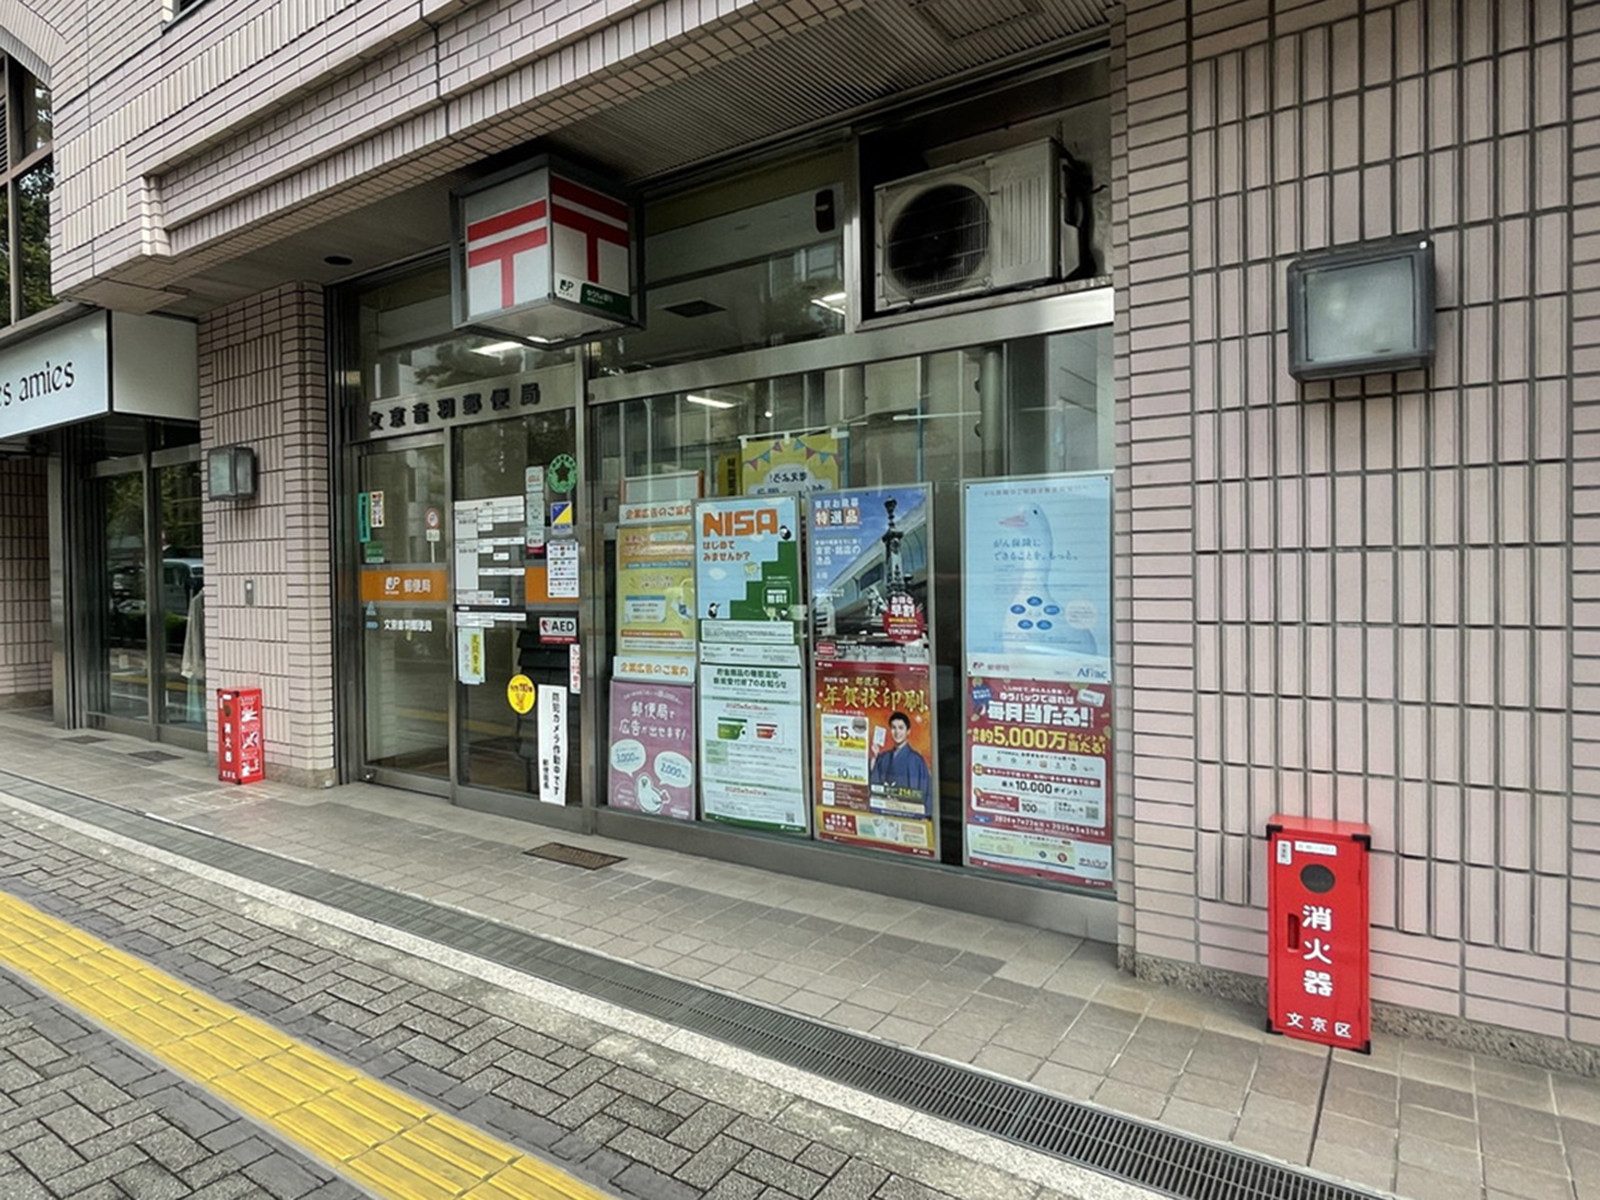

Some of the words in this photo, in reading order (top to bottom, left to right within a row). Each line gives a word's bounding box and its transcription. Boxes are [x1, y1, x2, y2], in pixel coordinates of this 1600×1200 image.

[0, 382, 12, 406] s
[19, 361, 75, 402] amies
[702, 508, 778, 538] NISA
[815, 509, 860, 526] 特選品
[702, 540, 735, 550] はじめて
[891, 604, 916, 618] 早割
[551, 620, 574, 632] AED
[1077, 667, 1107, 679] Aflac
[823, 684, 925, 714] 年賀状印刷
[1302, 904, 1333, 998] 消火器
[1286, 1012, 1352, 1039] 文京区
